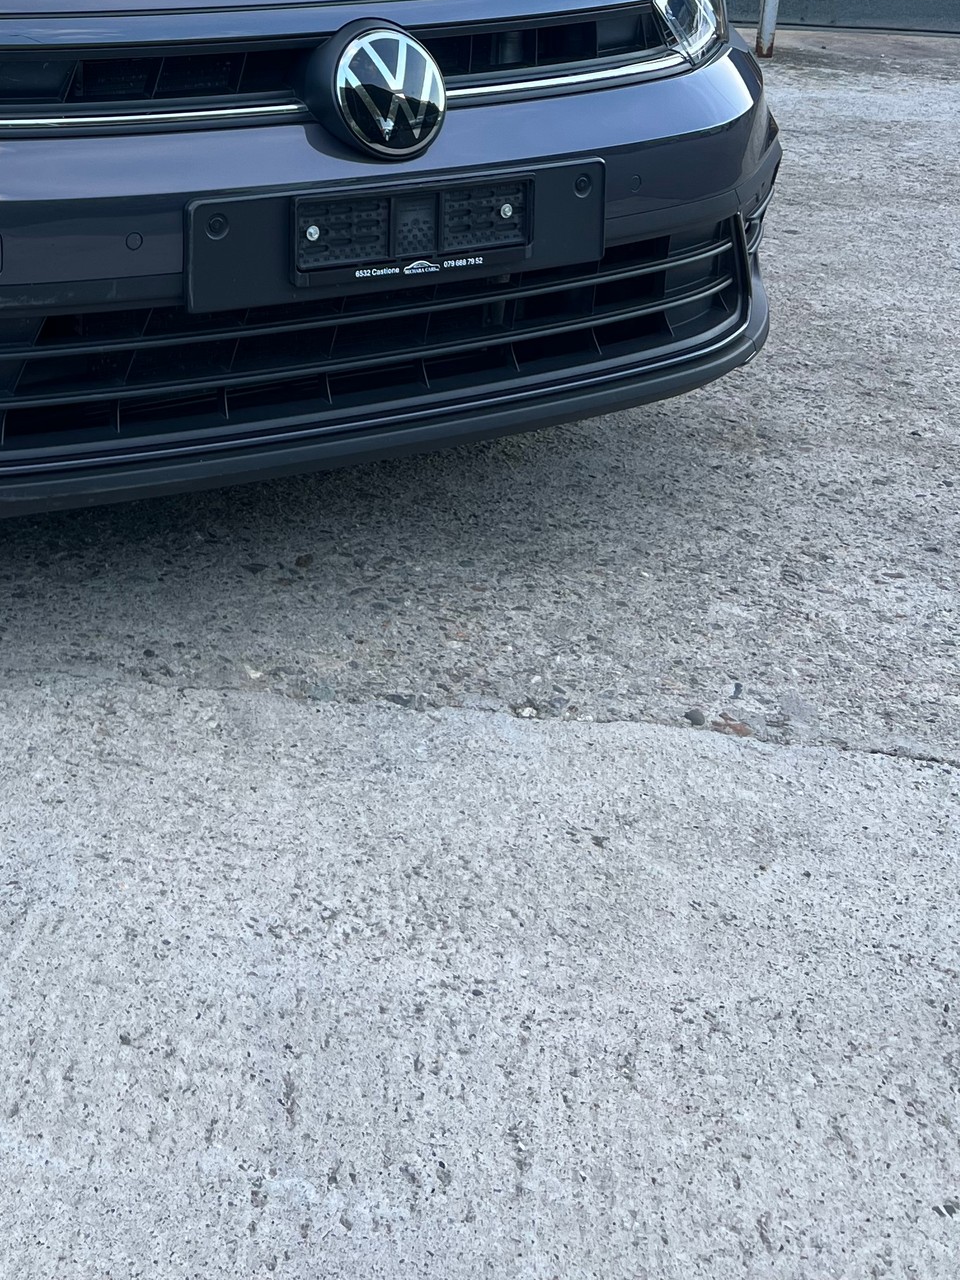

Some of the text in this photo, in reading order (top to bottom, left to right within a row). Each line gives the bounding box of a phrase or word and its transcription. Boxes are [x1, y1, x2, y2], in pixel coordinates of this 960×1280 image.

[467, 257, 475, 265] 79
[475, 256, 483, 264] 52
[355, 267, 400, 277] 6532 Castione
